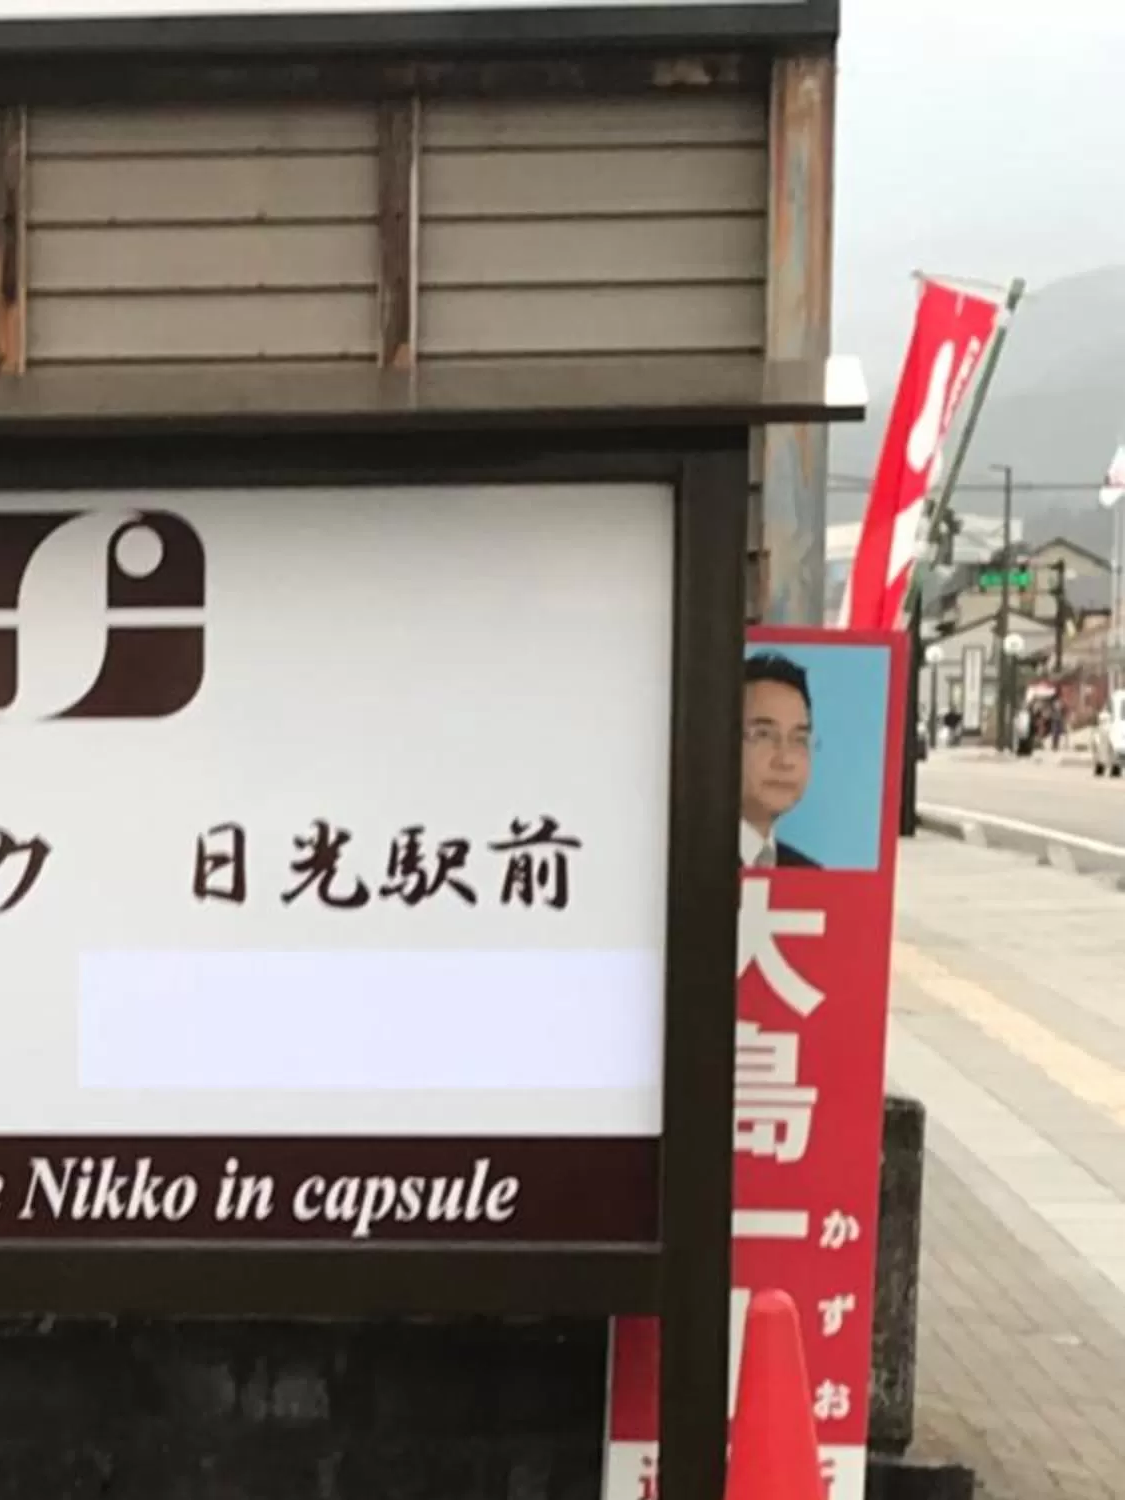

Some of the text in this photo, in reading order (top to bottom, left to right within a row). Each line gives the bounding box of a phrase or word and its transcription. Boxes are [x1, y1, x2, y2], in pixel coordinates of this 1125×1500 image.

[191, 815, 584, 910] 日光駅前
[18, 1156, 198, 1221] Nikko
[214, 1156, 275, 1221] in
[292, 1157, 521, 1239] capsule
[729, 876, 827, 1420] 大島一
[813, 1209, 861, 1420] かずお
